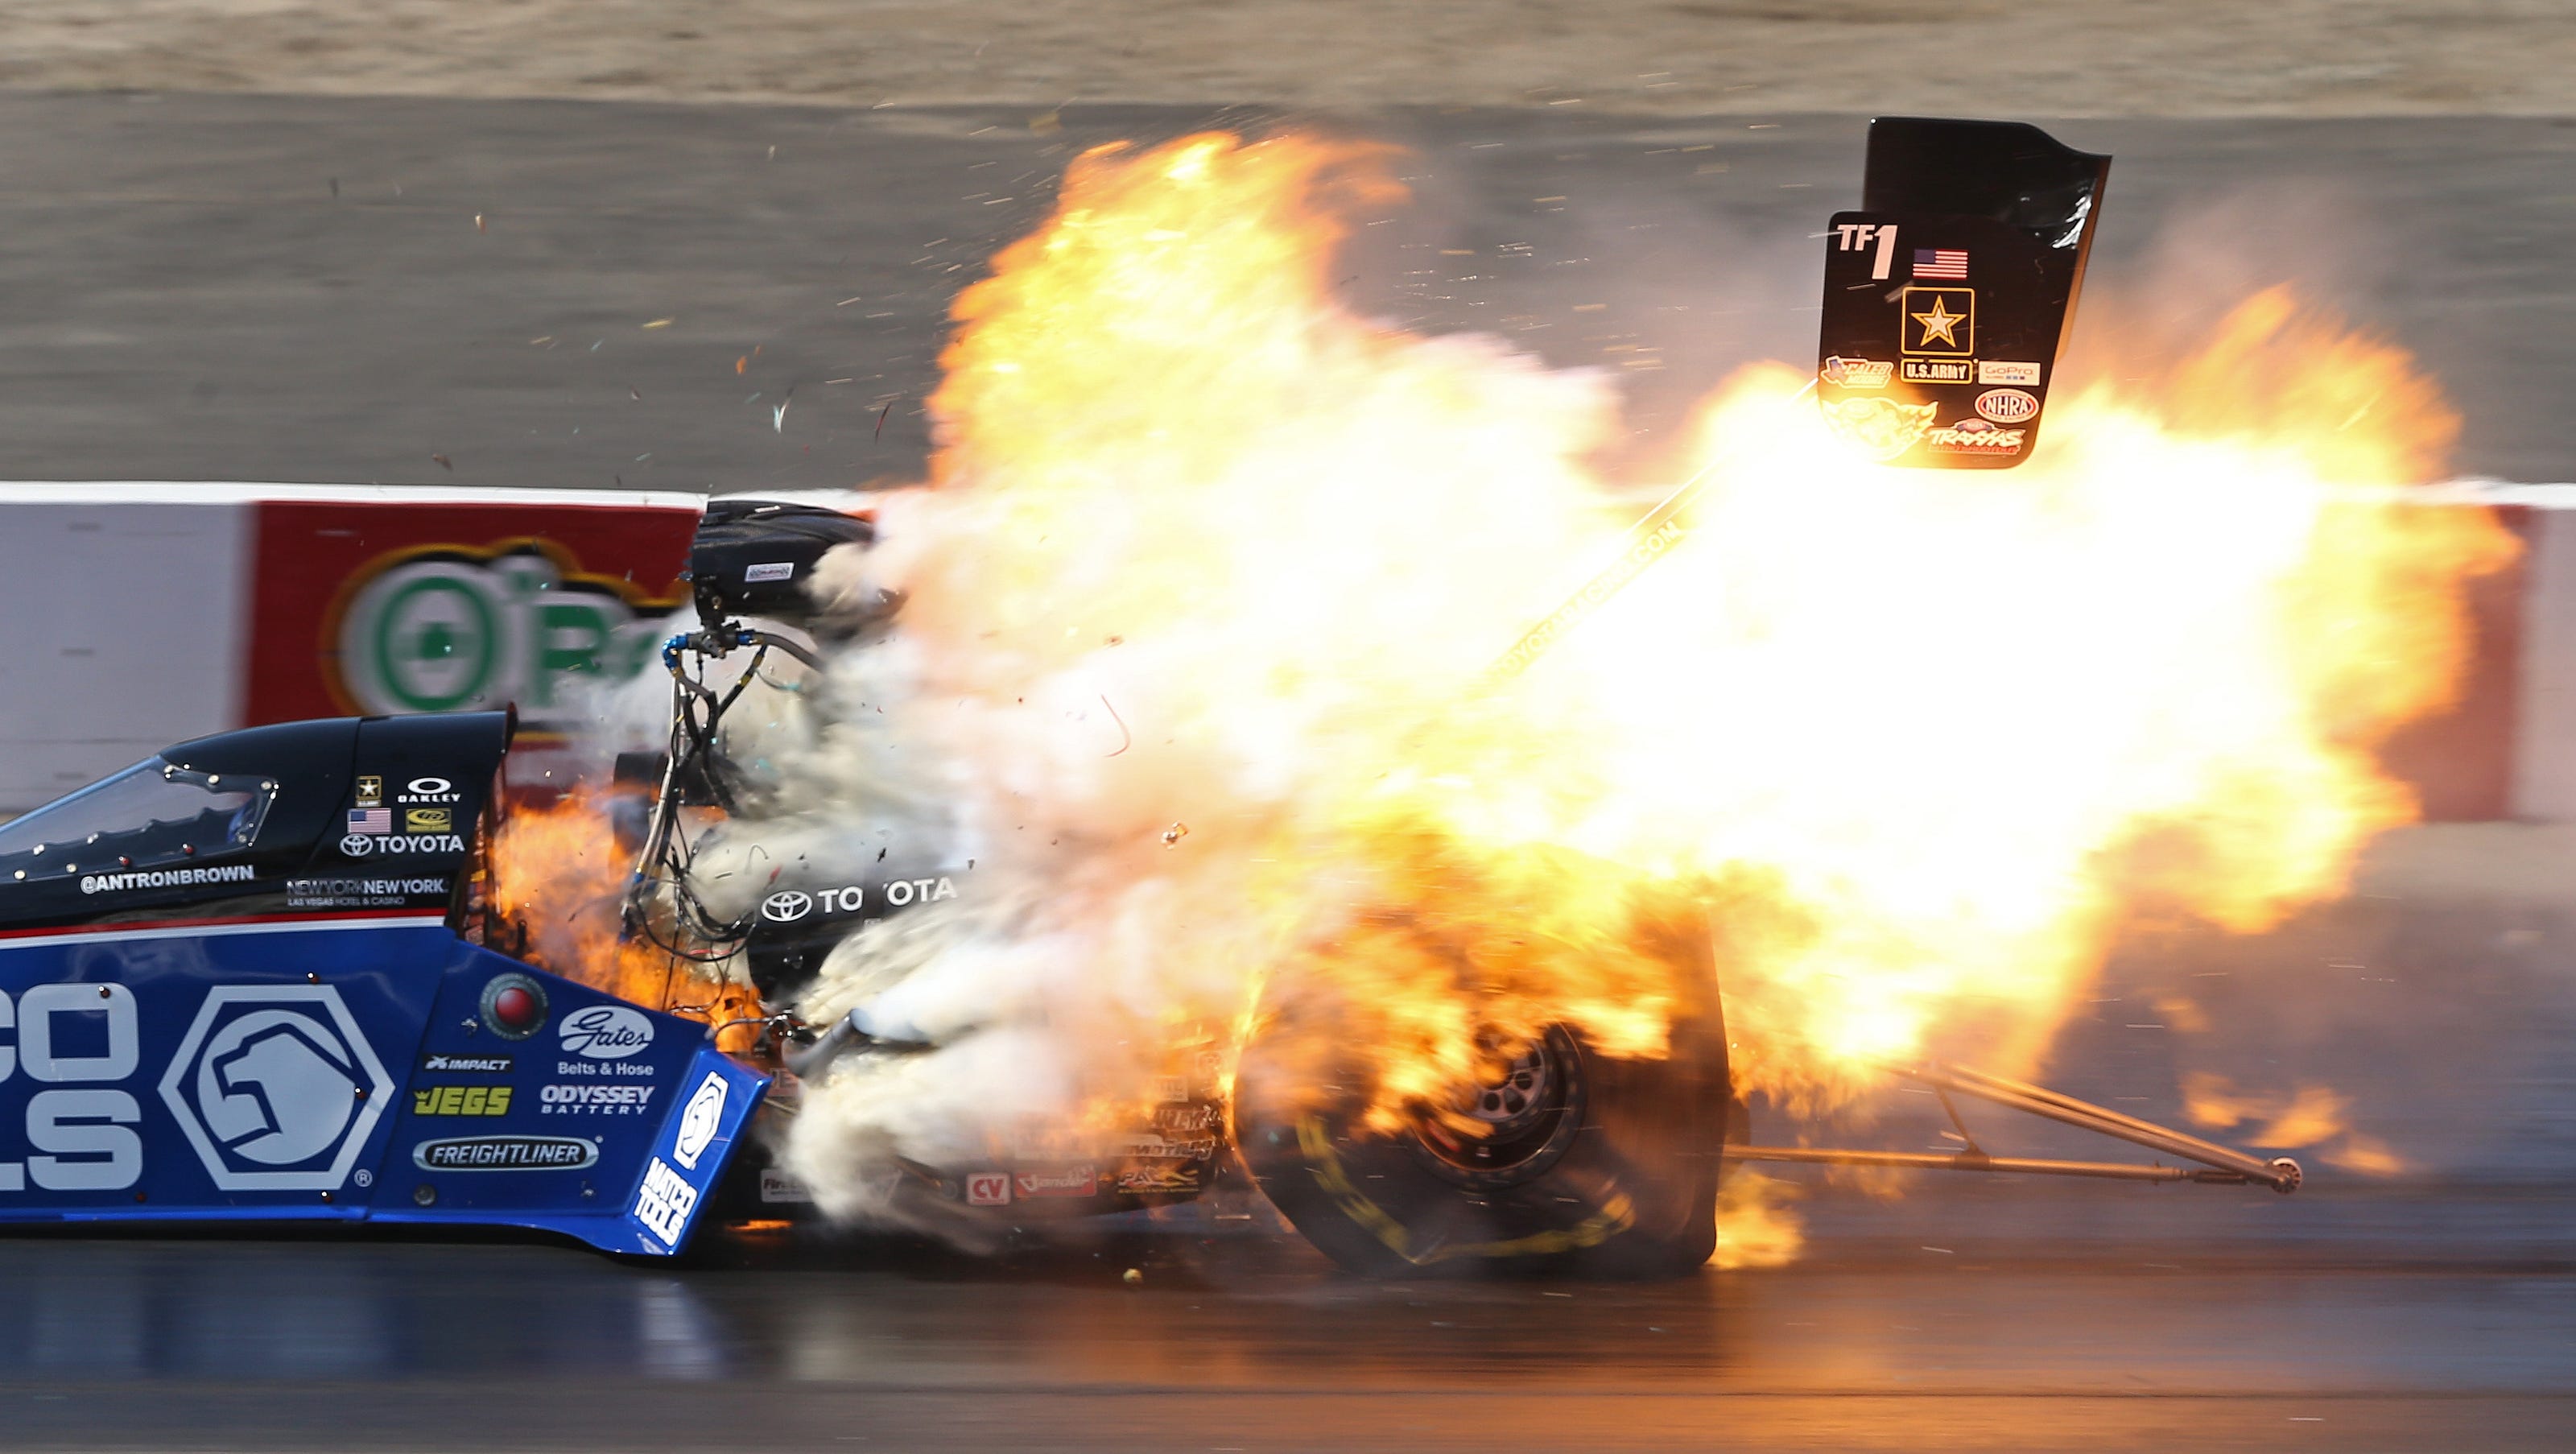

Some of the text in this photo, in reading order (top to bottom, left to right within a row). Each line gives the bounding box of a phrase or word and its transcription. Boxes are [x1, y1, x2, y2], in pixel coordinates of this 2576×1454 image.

[1844, 363, 1889, 375] CALEB
[1985, 394, 2029, 416] NHRA
[1928, 429, 2027, 448] TRAXXAS
[397, 793, 461, 803] OAKLEY
[375, 835, 465, 853] TOYOTA
[80, 864, 255, 894] @ANTRONBROWN
[817, 875, 958, 914] TOOTA
[559, 1010, 651, 1051] Gates
[448, 1059, 511, 1071] IMPACT
[557, 1062, 654, 1076] Belts & Hose
[413, 1087, 514, 1116] JEGS
[540, 1084, 655, 1104] ODYSSEY
[540, 1105, 647, 1115] BATTERY
[431, 1144, 581, 1165] FREIGHTLINER
[642, 1156, 698, 1219] MATCO
[972, 1179, 1005, 1199] CV
[634, 1184, 686, 1246] TOOLS
